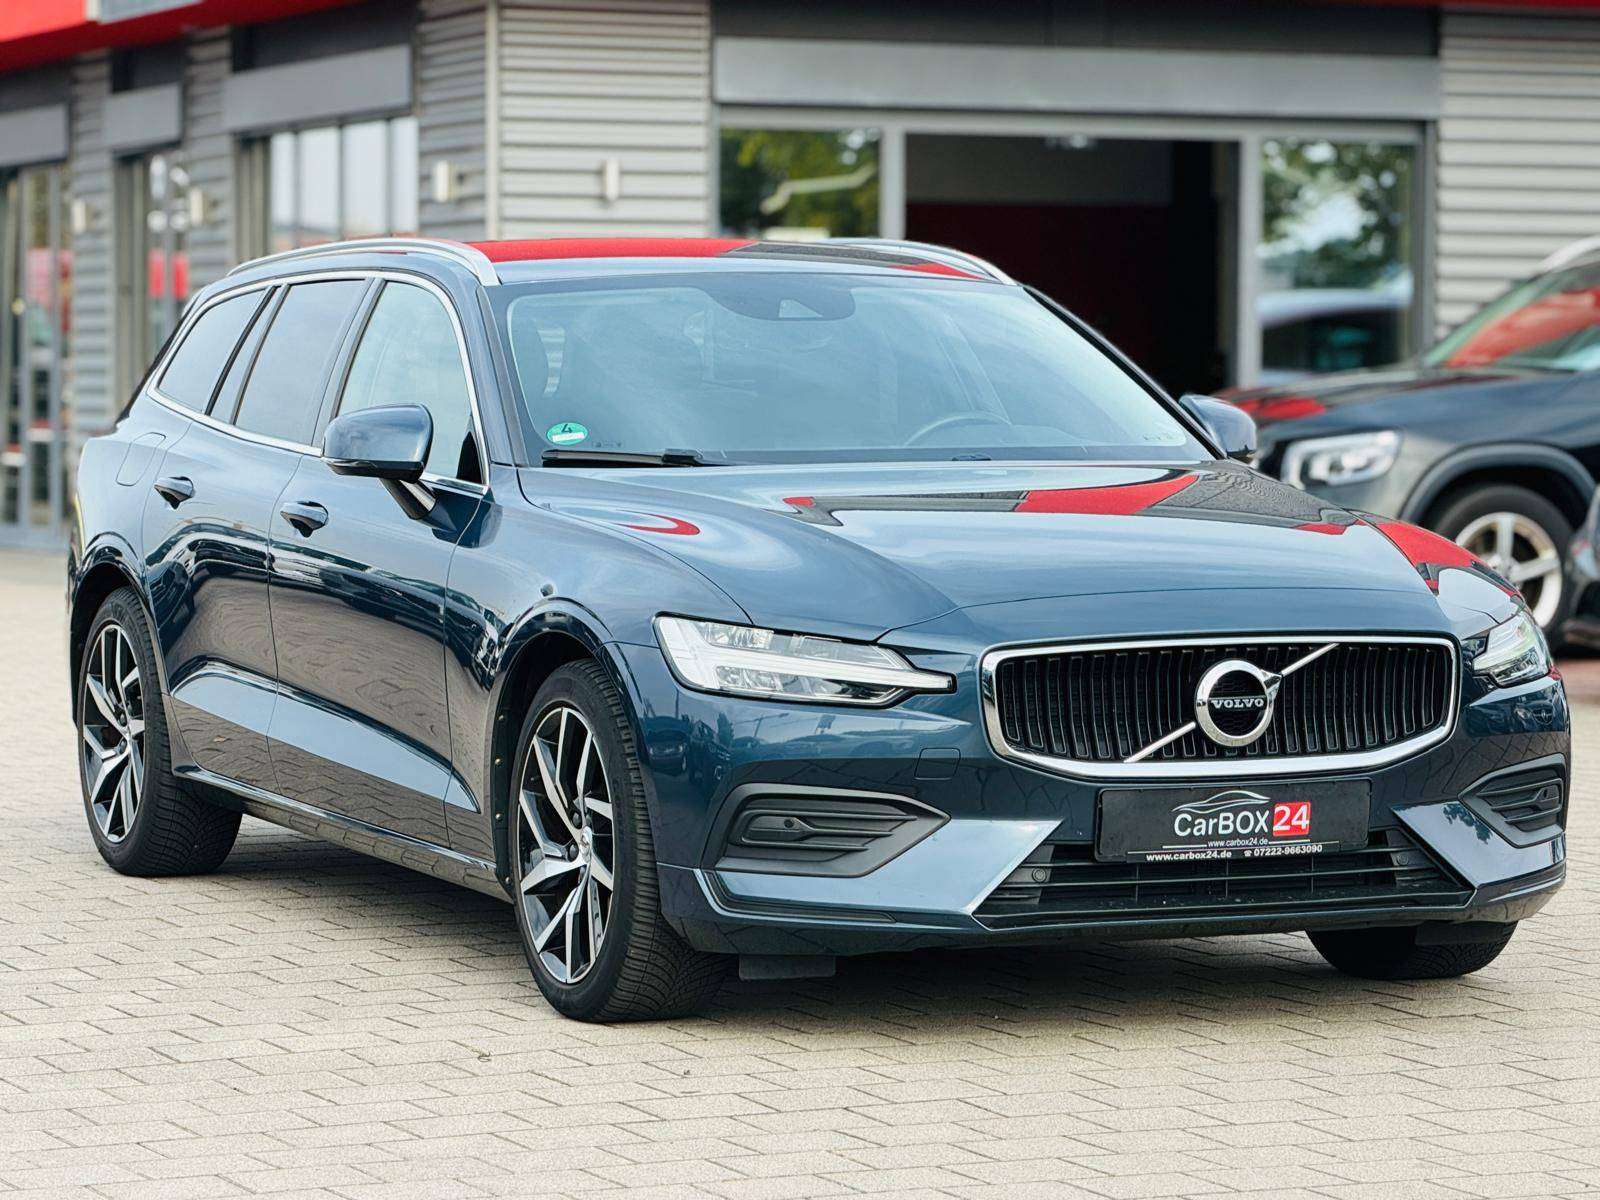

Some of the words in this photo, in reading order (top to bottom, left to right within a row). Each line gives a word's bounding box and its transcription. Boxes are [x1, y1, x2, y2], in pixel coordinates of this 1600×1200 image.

[1211, 698, 1264, 709] VOLVO
[1207, 838, 1268, 848] www.carbox24.de
[1146, 850, 1232, 861] www.carbox24.de
[1253, 844, 1323, 857] 07222-9663090
